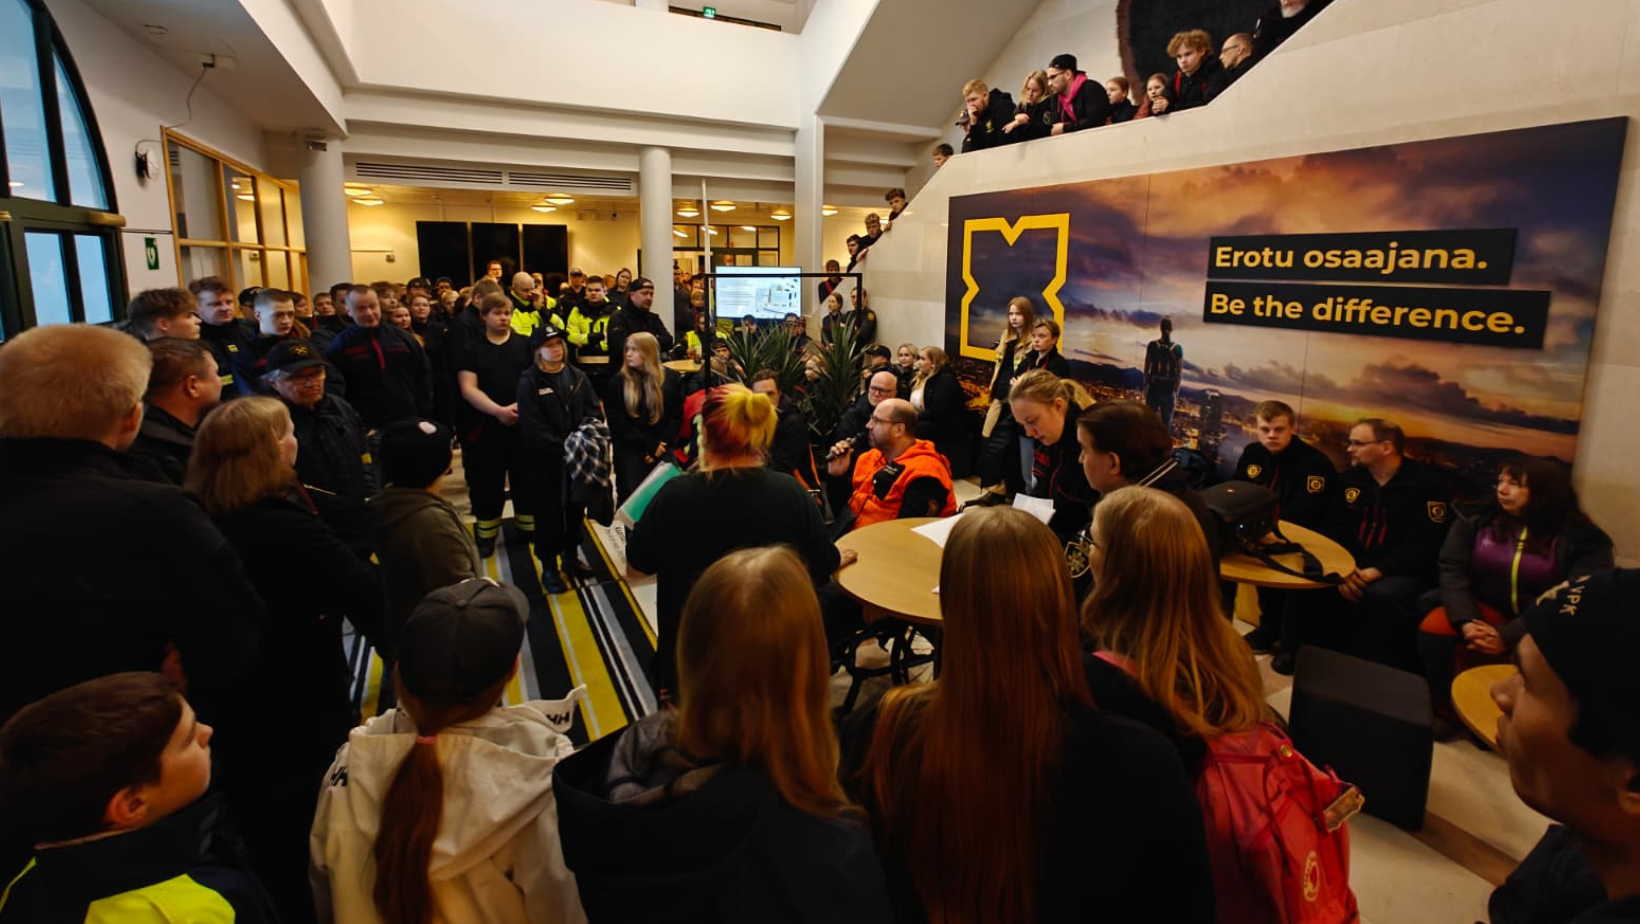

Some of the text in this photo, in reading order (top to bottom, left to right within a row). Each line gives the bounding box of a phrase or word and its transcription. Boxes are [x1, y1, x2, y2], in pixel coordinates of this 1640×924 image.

[1215, 241, 1488, 275] Erotu osaajana.
[1210, 293, 1526, 334] Be the difference.
[546, 711, 570, 725] HH
